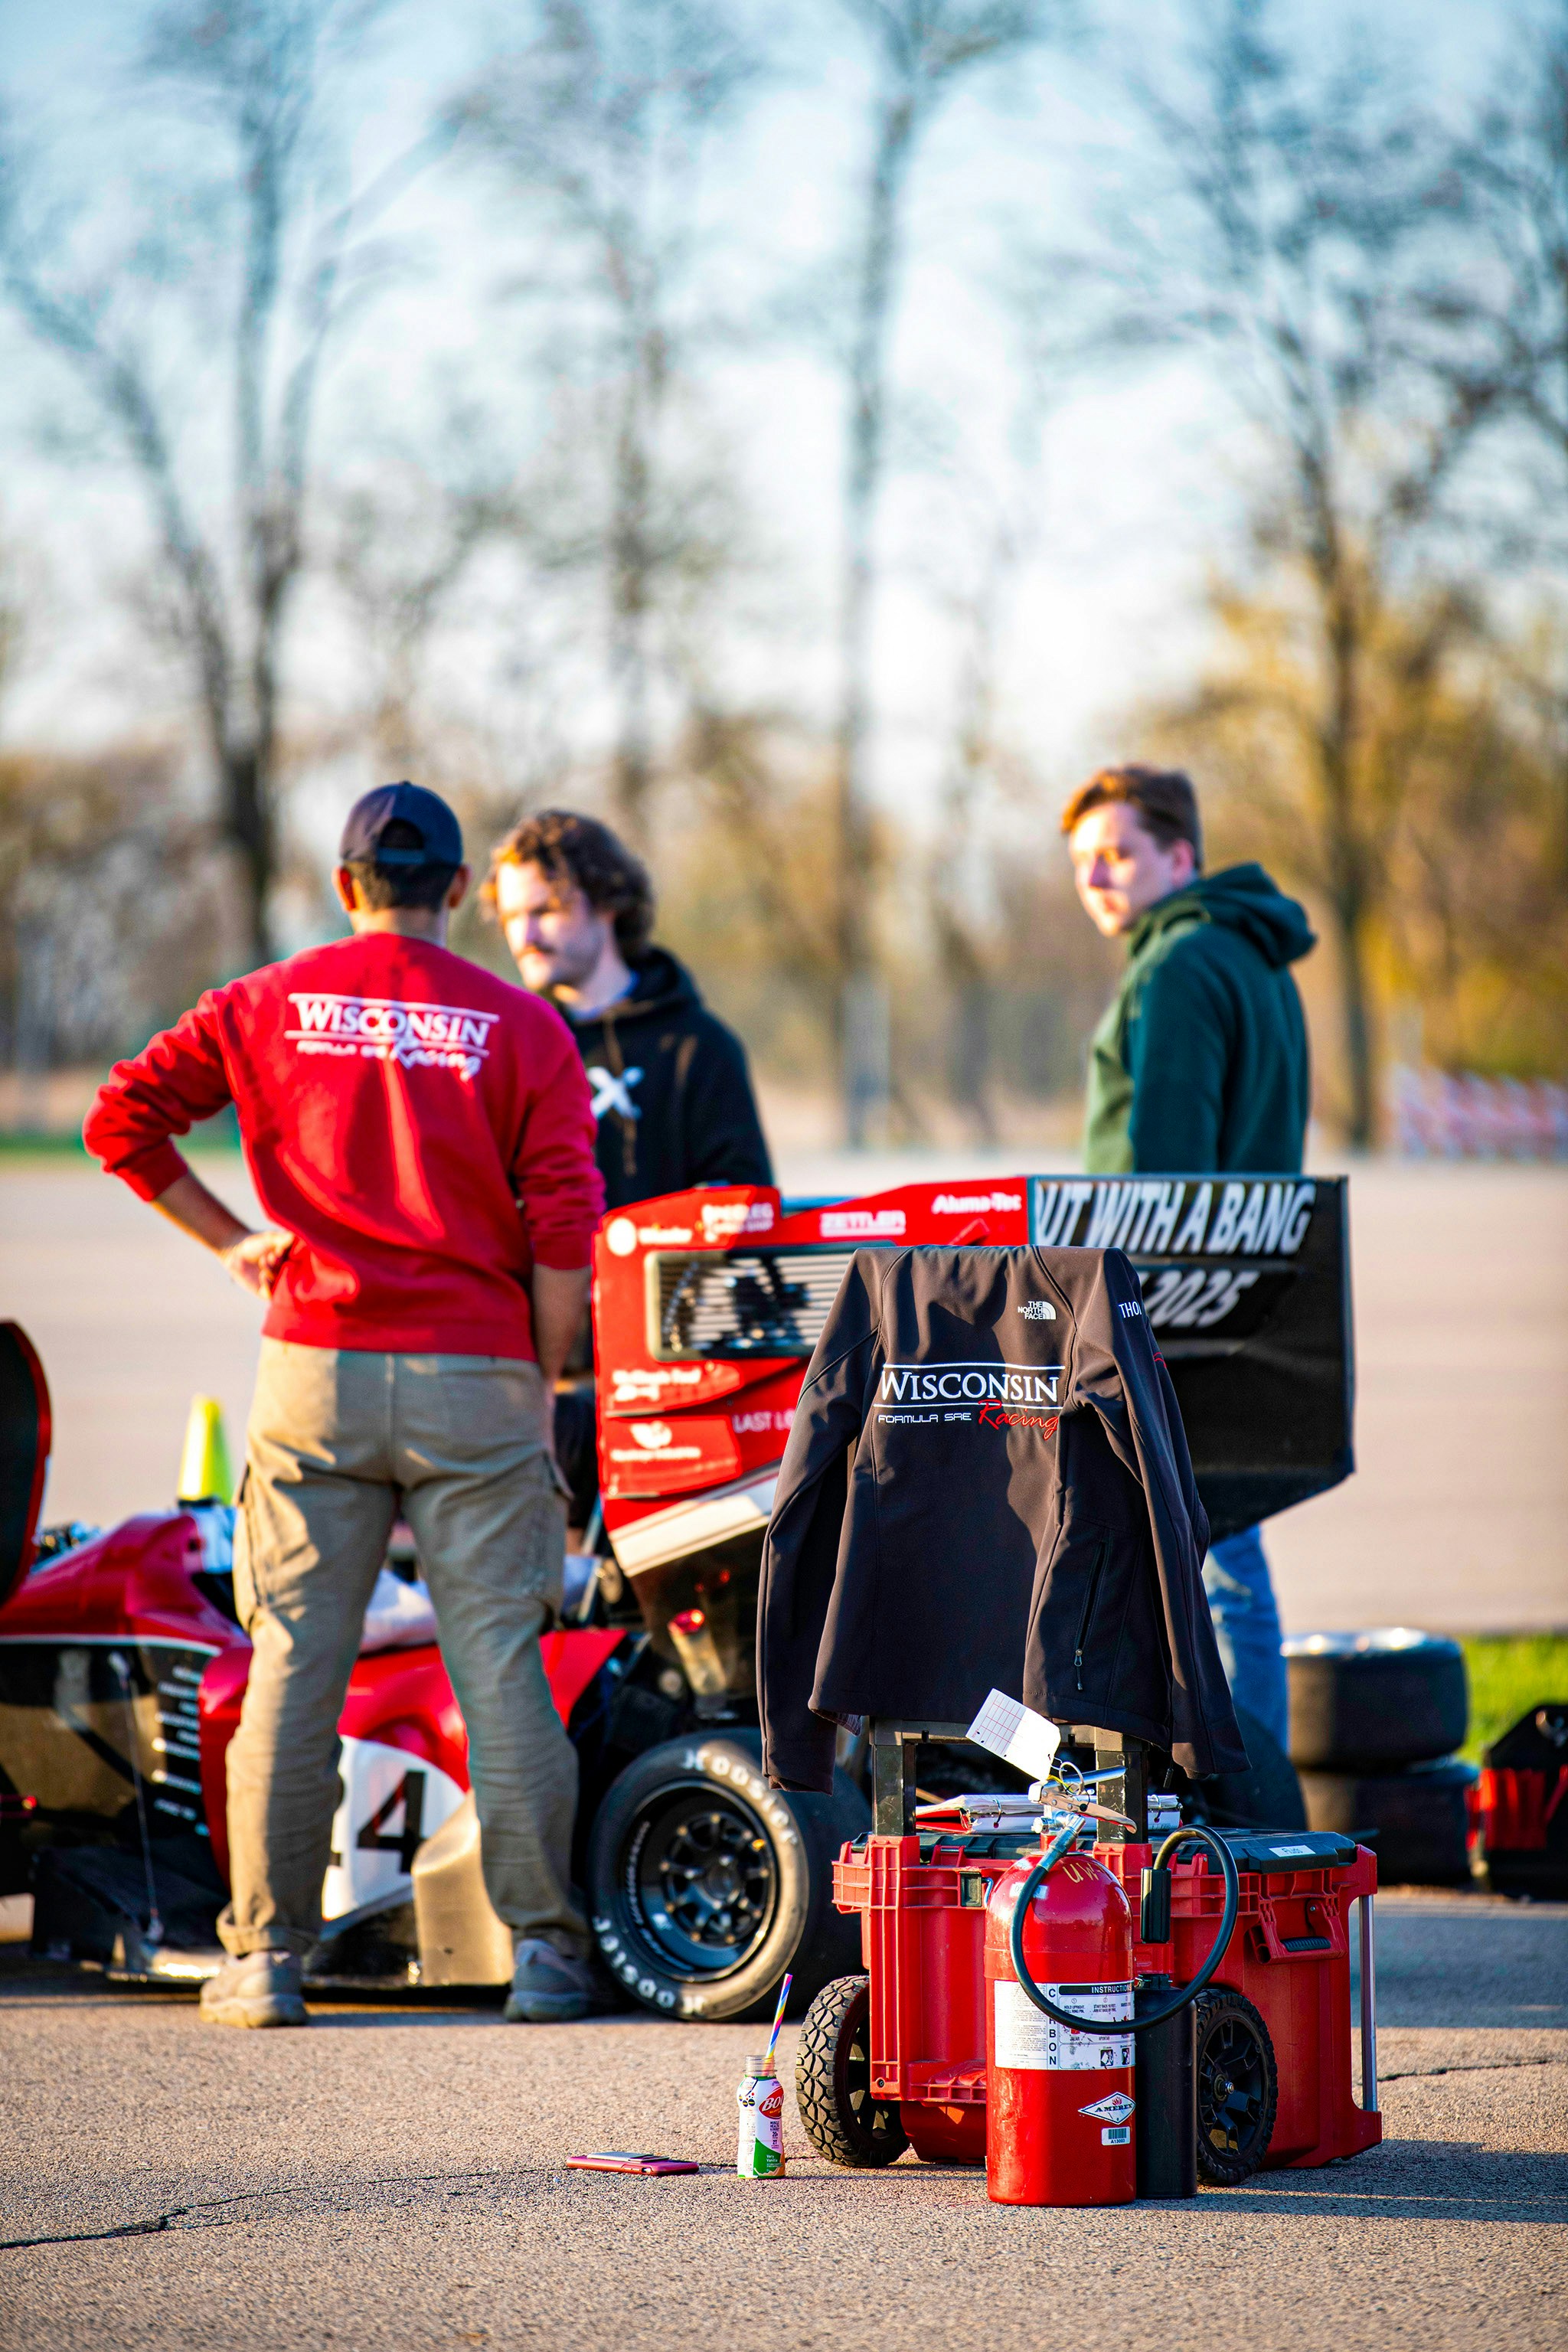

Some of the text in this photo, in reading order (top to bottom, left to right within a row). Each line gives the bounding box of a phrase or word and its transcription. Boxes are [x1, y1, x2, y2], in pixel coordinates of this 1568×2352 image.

[296, 999, 490, 1047] WISCONSIN
[1084, 1181, 1186, 1254] WITH
[1173, 1181, 1213, 1255] A
[1207, 1182, 1317, 1256] BANG
[1148, 1269, 1260, 1328] 2025
[881, 1370, 1059, 1403] WISCONSIN
[732, 1410, 772, 1433] LAST
[878, 1399, 1060, 1441] FORMULA SAE Racing
[331, 1769, 426, 1874] 4
[1095, 2103, 1132, 2113] AMEREX
